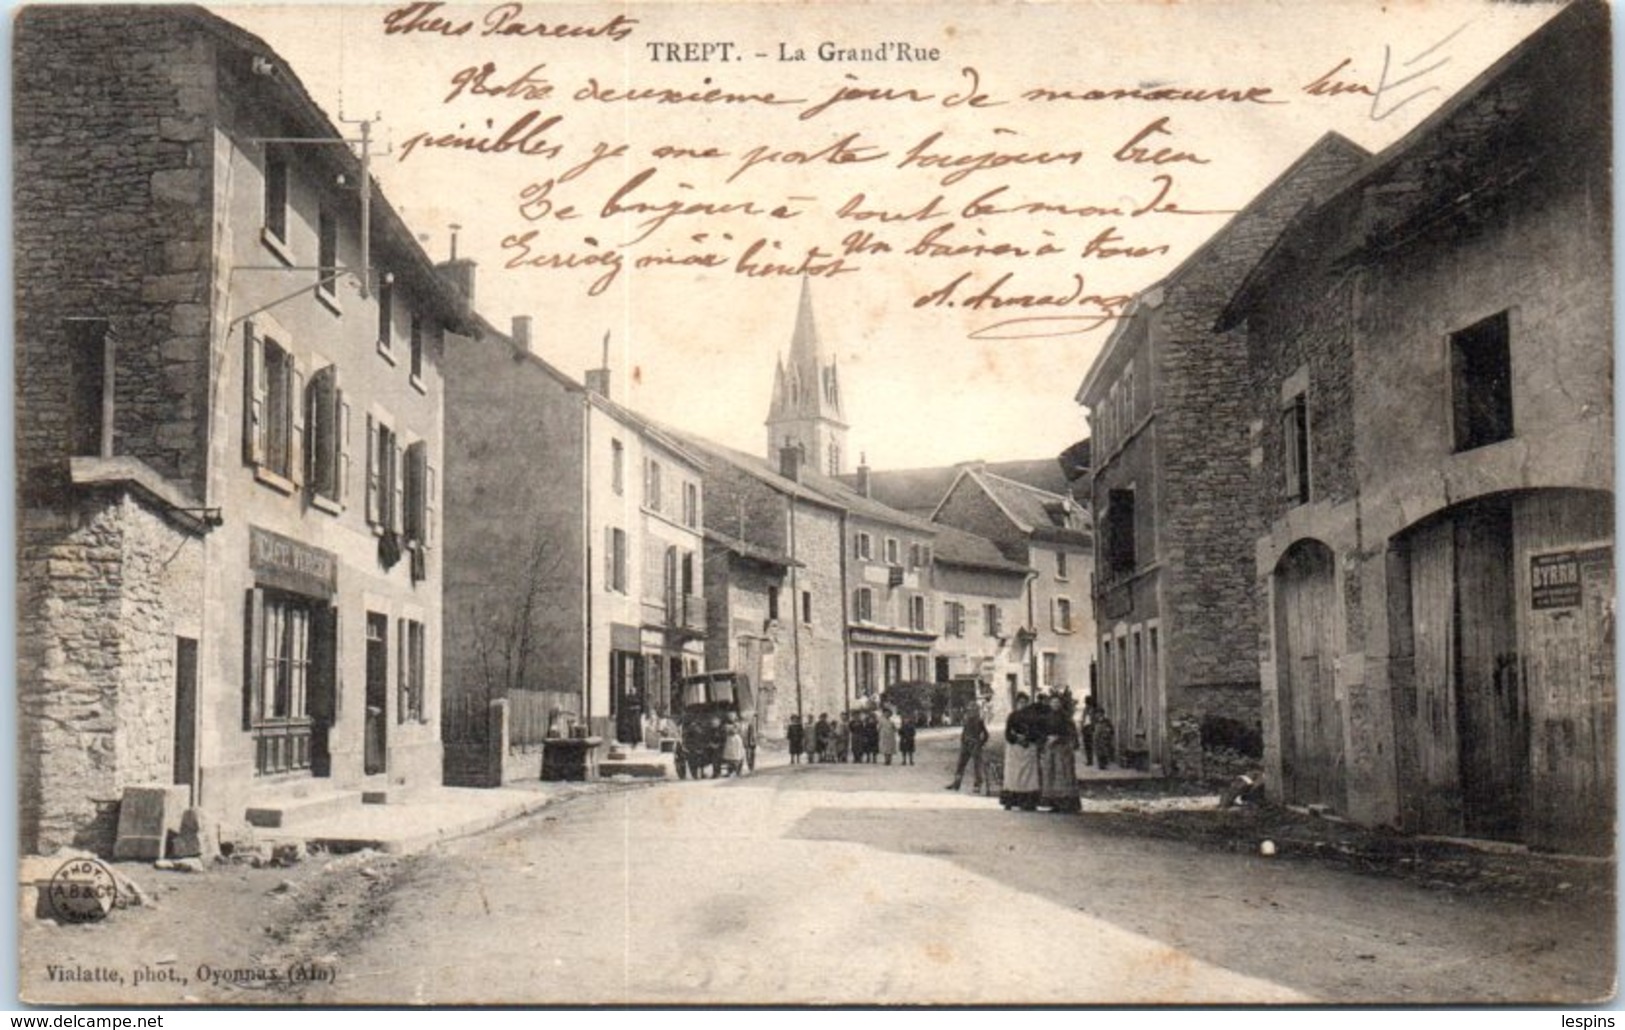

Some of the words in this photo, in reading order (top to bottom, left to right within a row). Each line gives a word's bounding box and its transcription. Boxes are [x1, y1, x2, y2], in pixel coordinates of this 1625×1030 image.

[481, 2, 640, 41] Parents
[799, 73, 936, 120] jour
[942, 67, 1010, 107] de
[726, 132, 890, 183] porte
